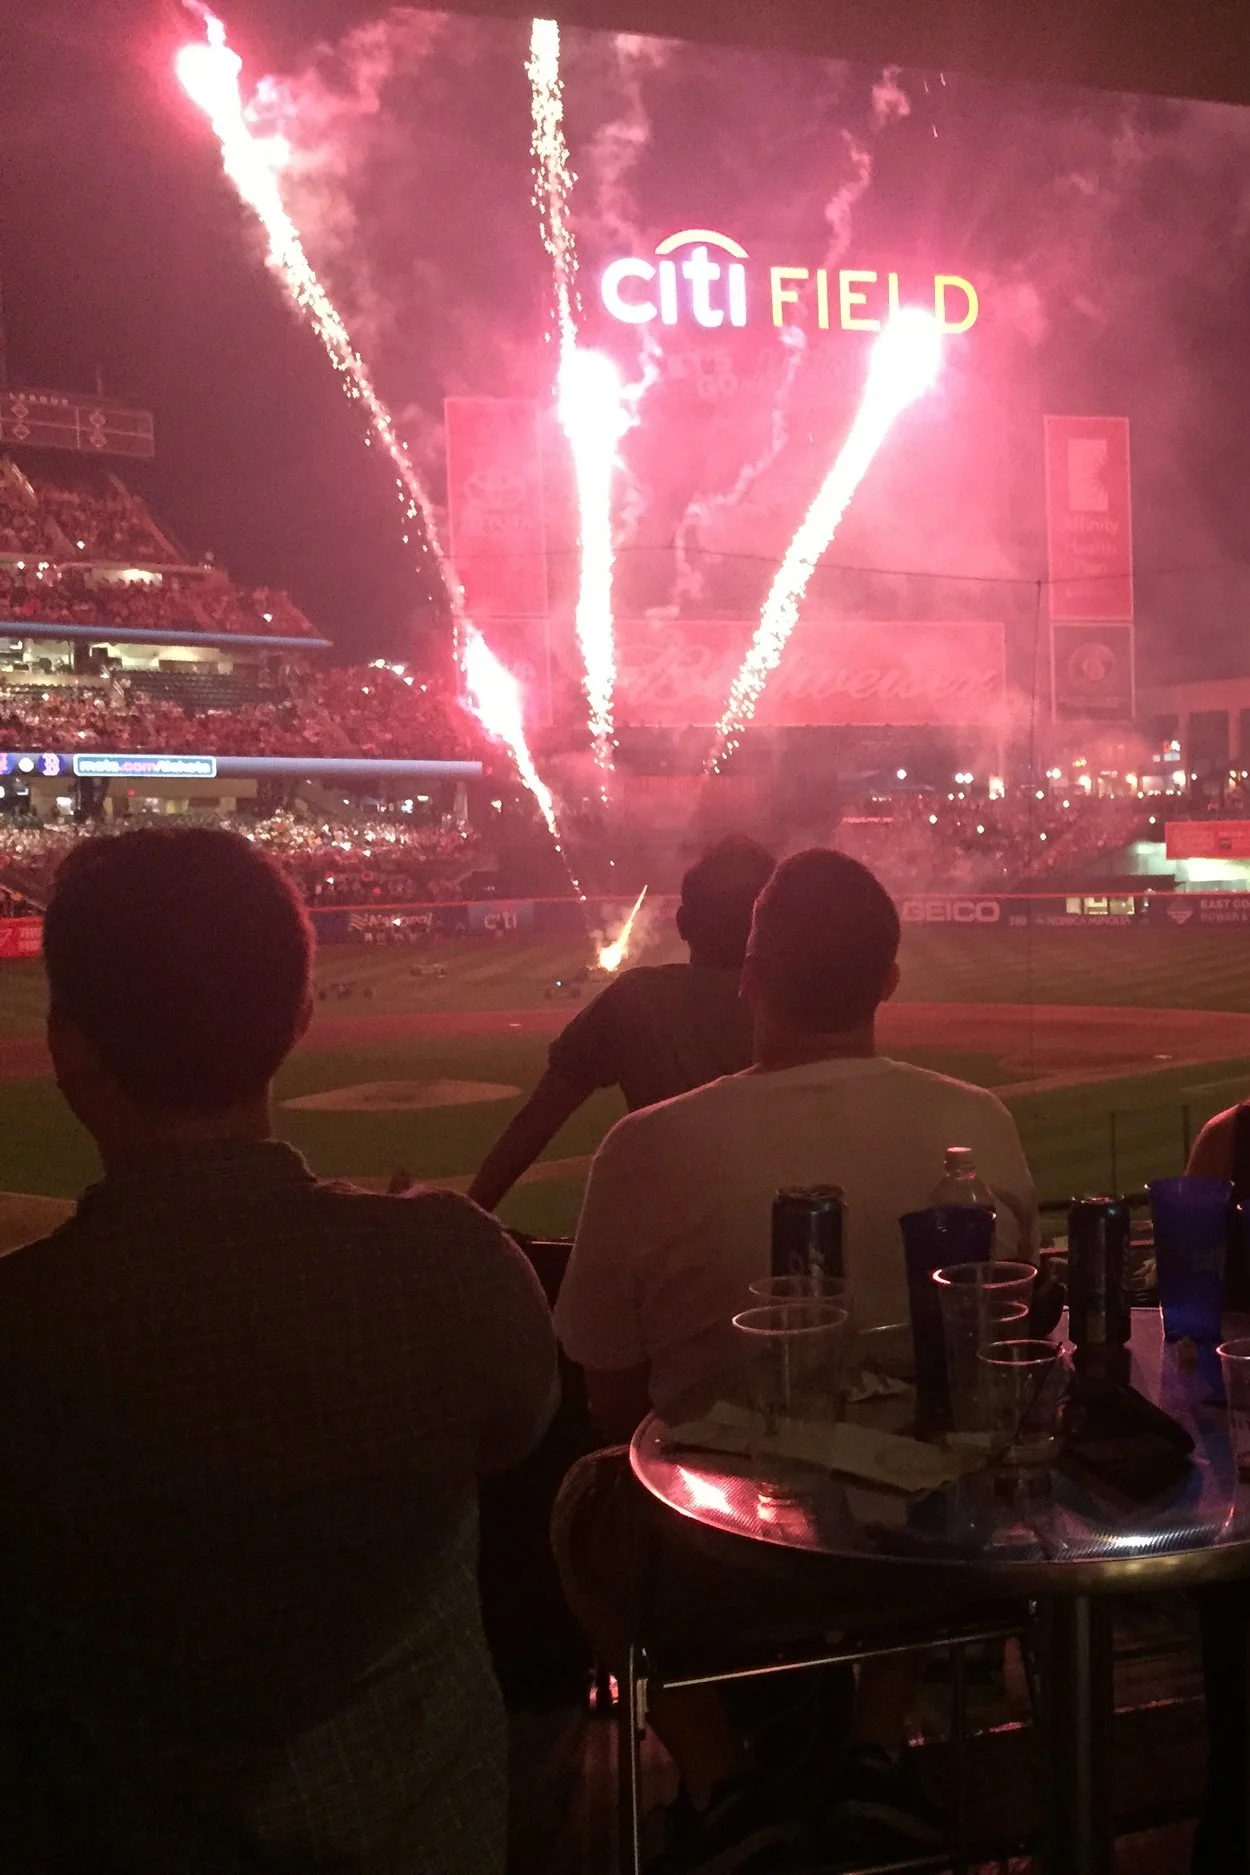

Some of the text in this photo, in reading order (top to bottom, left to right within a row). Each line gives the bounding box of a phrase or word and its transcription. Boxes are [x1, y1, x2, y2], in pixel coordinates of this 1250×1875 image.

[600, 240, 748, 329] citi
[1061, 514, 1119, 536] Affinity
[620, 640, 997, 706] Buweiser
[367, 903, 434, 930] Naional
[901, 900, 1000, 923] GEICO
[1200, 899, 1231, 909] EAST
